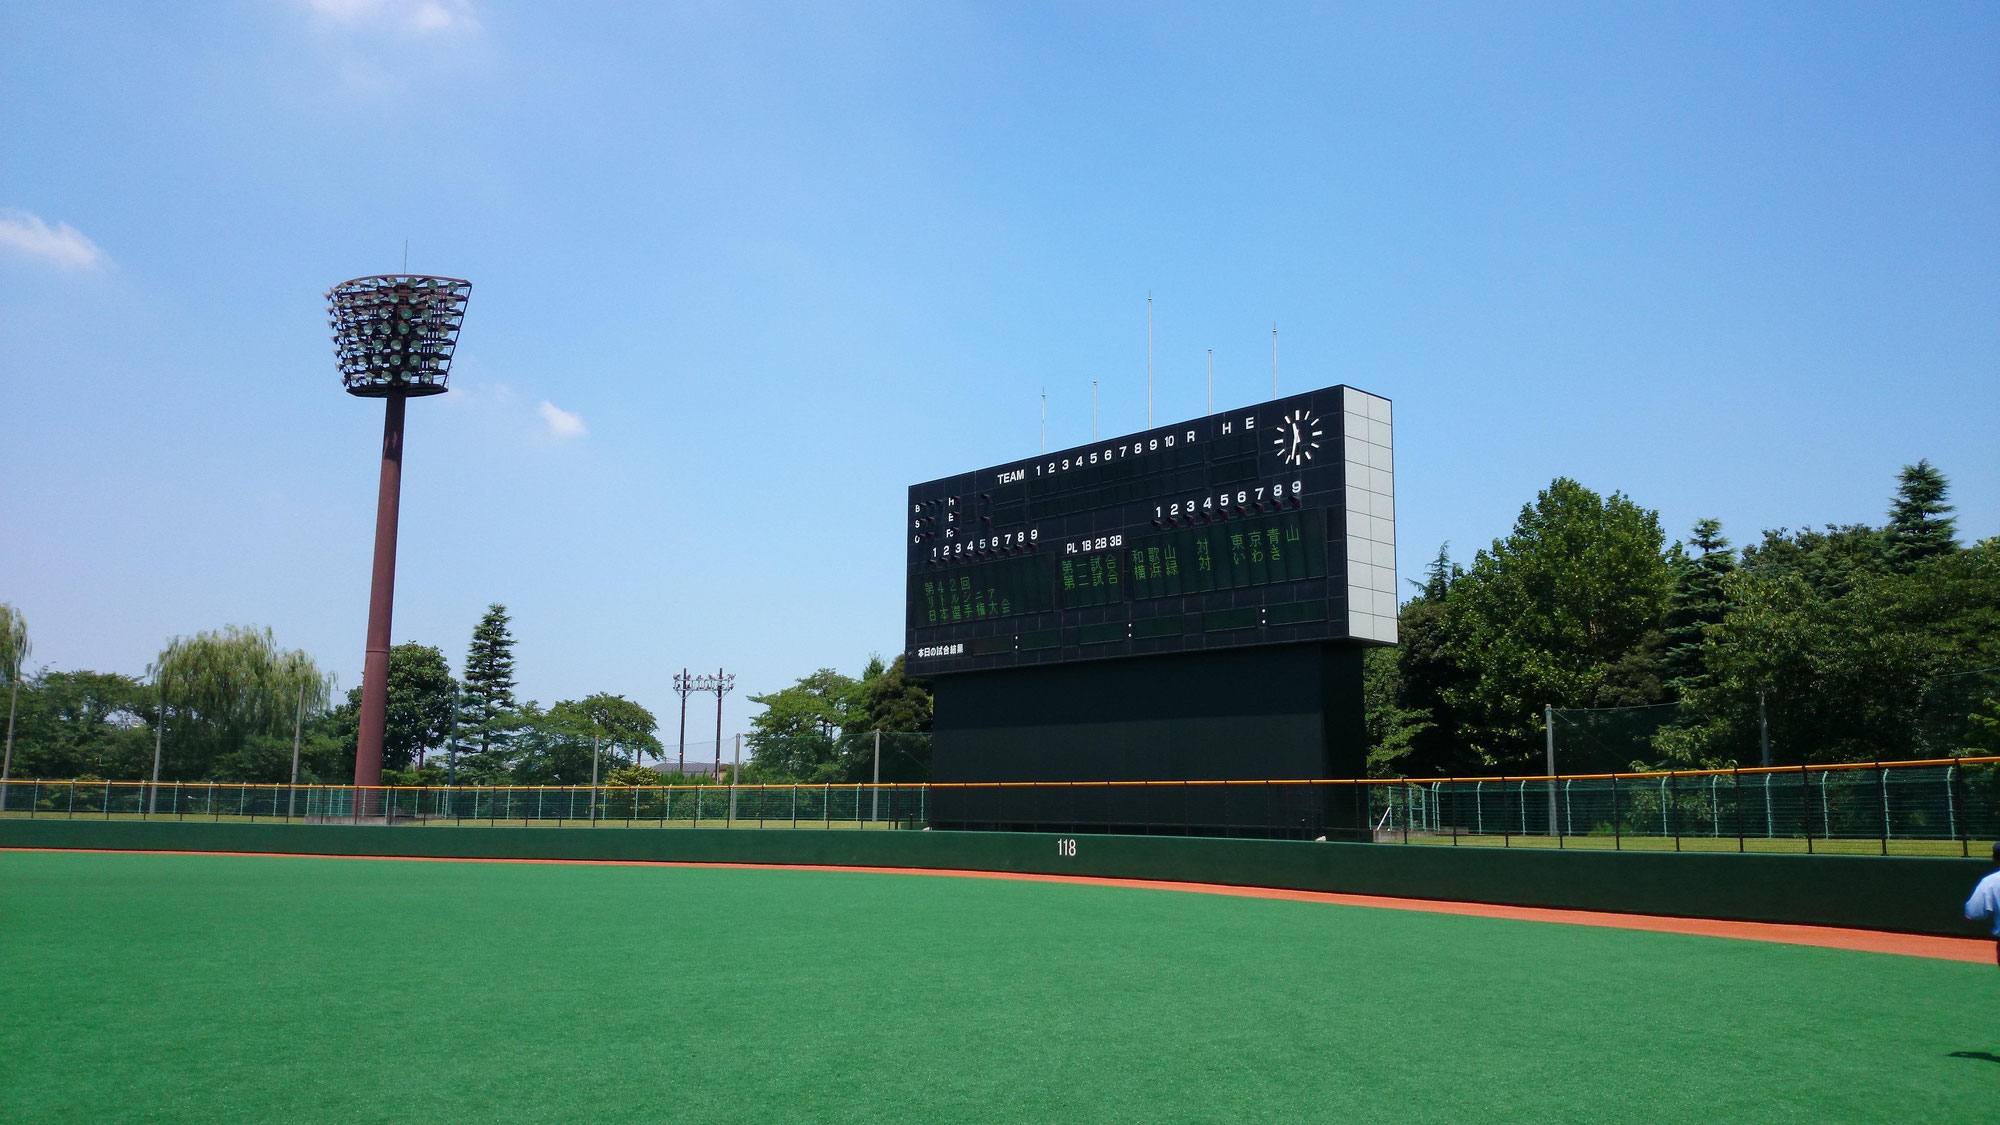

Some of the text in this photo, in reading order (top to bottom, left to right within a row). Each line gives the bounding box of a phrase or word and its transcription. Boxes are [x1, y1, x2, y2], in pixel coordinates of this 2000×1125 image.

[997, 416, 1255, 485] TEAM 1 2 3 4 5 6 7 8 9 10 R H E
[915, 504, 920, 513] B
[948, 497, 955, 506] H
[1155, 480, 1302, 518] 1 2 3 4 5 6 7 8 9
[915, 519, 920, 528] S
[948, 513, 954, 522] E
[932, 529, 1038, 558] 1 2 3 4 5 6 7 8 9
[1062, 524, 1299, 576] 第一試合 和歌山 対 東京青山
[1066, 534, 1122, 554] PL 1B 2B 3B
[1063, 568, 1118, 591] 第二試合
[1199, 555, 1210, 571] 対
[1233, 545, 1280, 565] いわき
[928, 598, 1010, 622] 日本選手権大会
[917, 643, 964, 658] 本日の試合結果
[1057, 838, 1077, 857] 118
